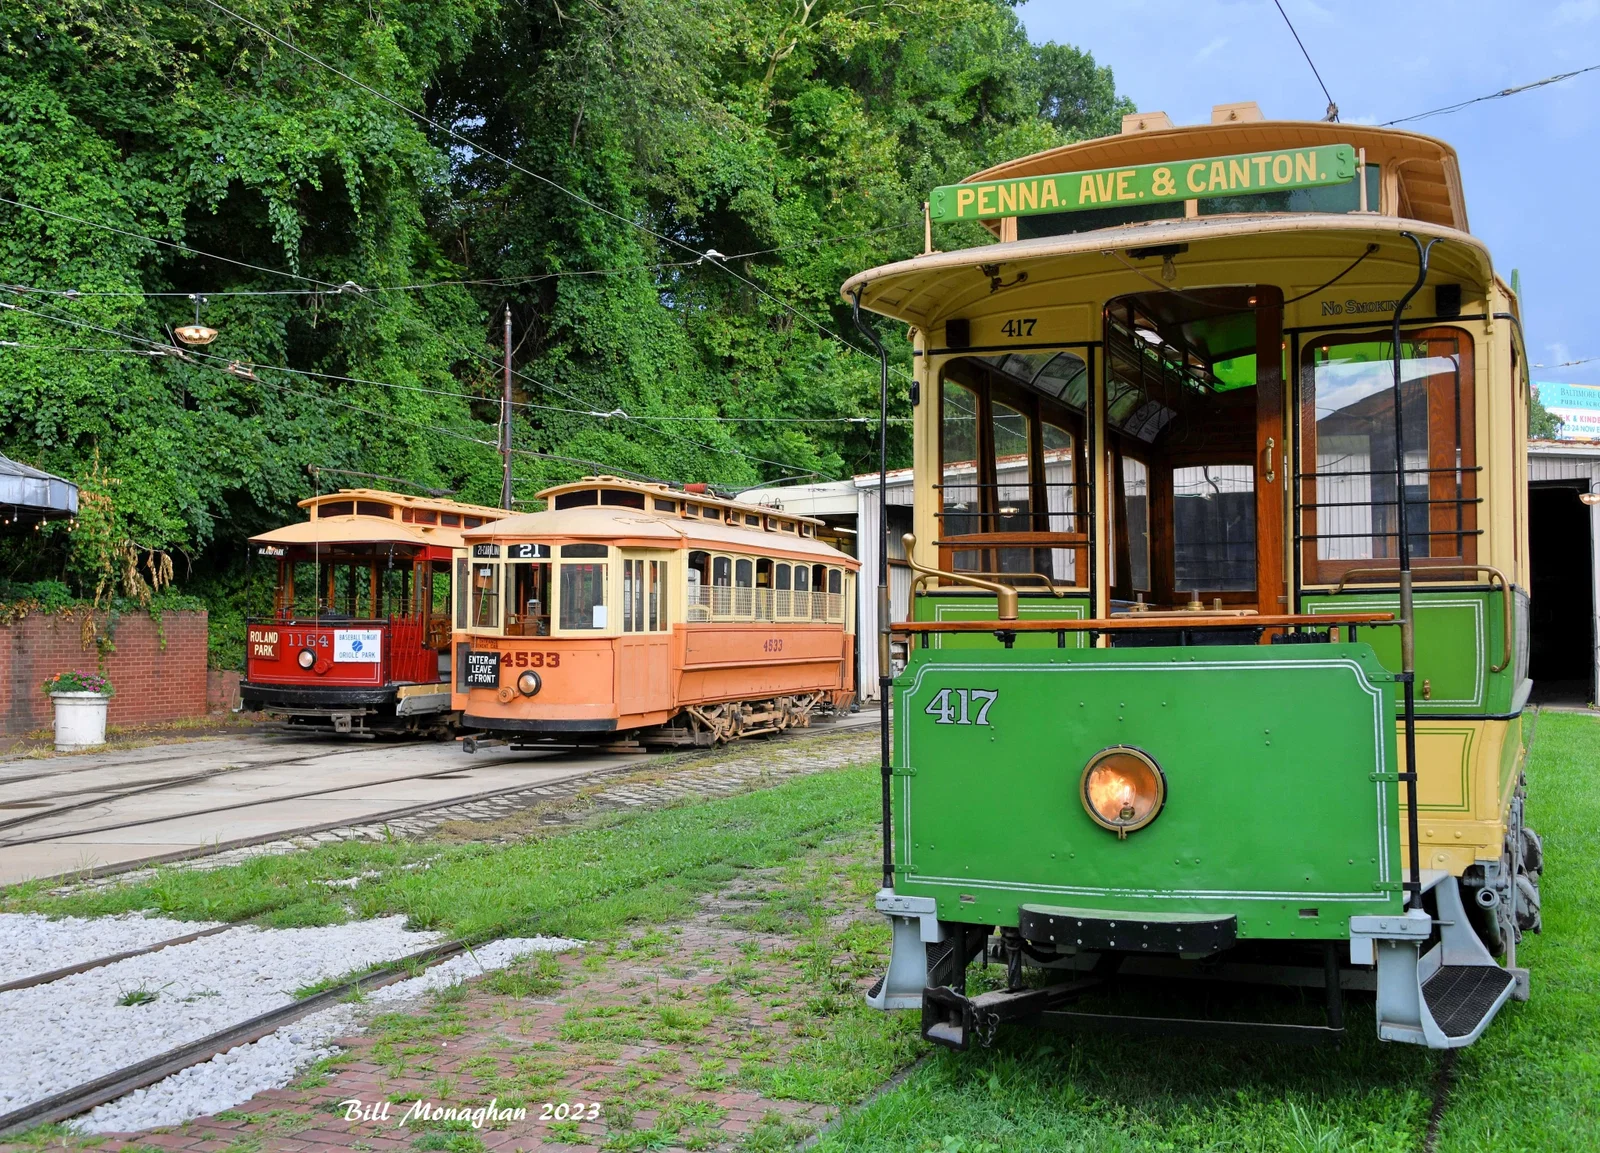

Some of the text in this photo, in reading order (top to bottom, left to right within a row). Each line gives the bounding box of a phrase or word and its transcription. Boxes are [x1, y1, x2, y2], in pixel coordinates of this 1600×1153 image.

[957, 151, 1327, 217] PENNA. AVE. & CANTON.
[1001, 318, 1038, 337] 417
[1560, 388, 1597, 399] BALTIMORE
[520, 544, 540, 558] 21
[250, 631, 278, 644] ROLAND
[288, 633, 329, 648] 1164
[254, 644, 274, 657] PARK.
[763, 639, 783, 652] 4533
[339, 651, 359, 659] ORIOLE
[468, 655, 497, 665] ENTER and
[500, 651, 560, 668] 4533
[471, 664, 492, 674] LEAVE
[467, 674, 496, 683] at FRONT
[924, 688, 999, 726] 417
